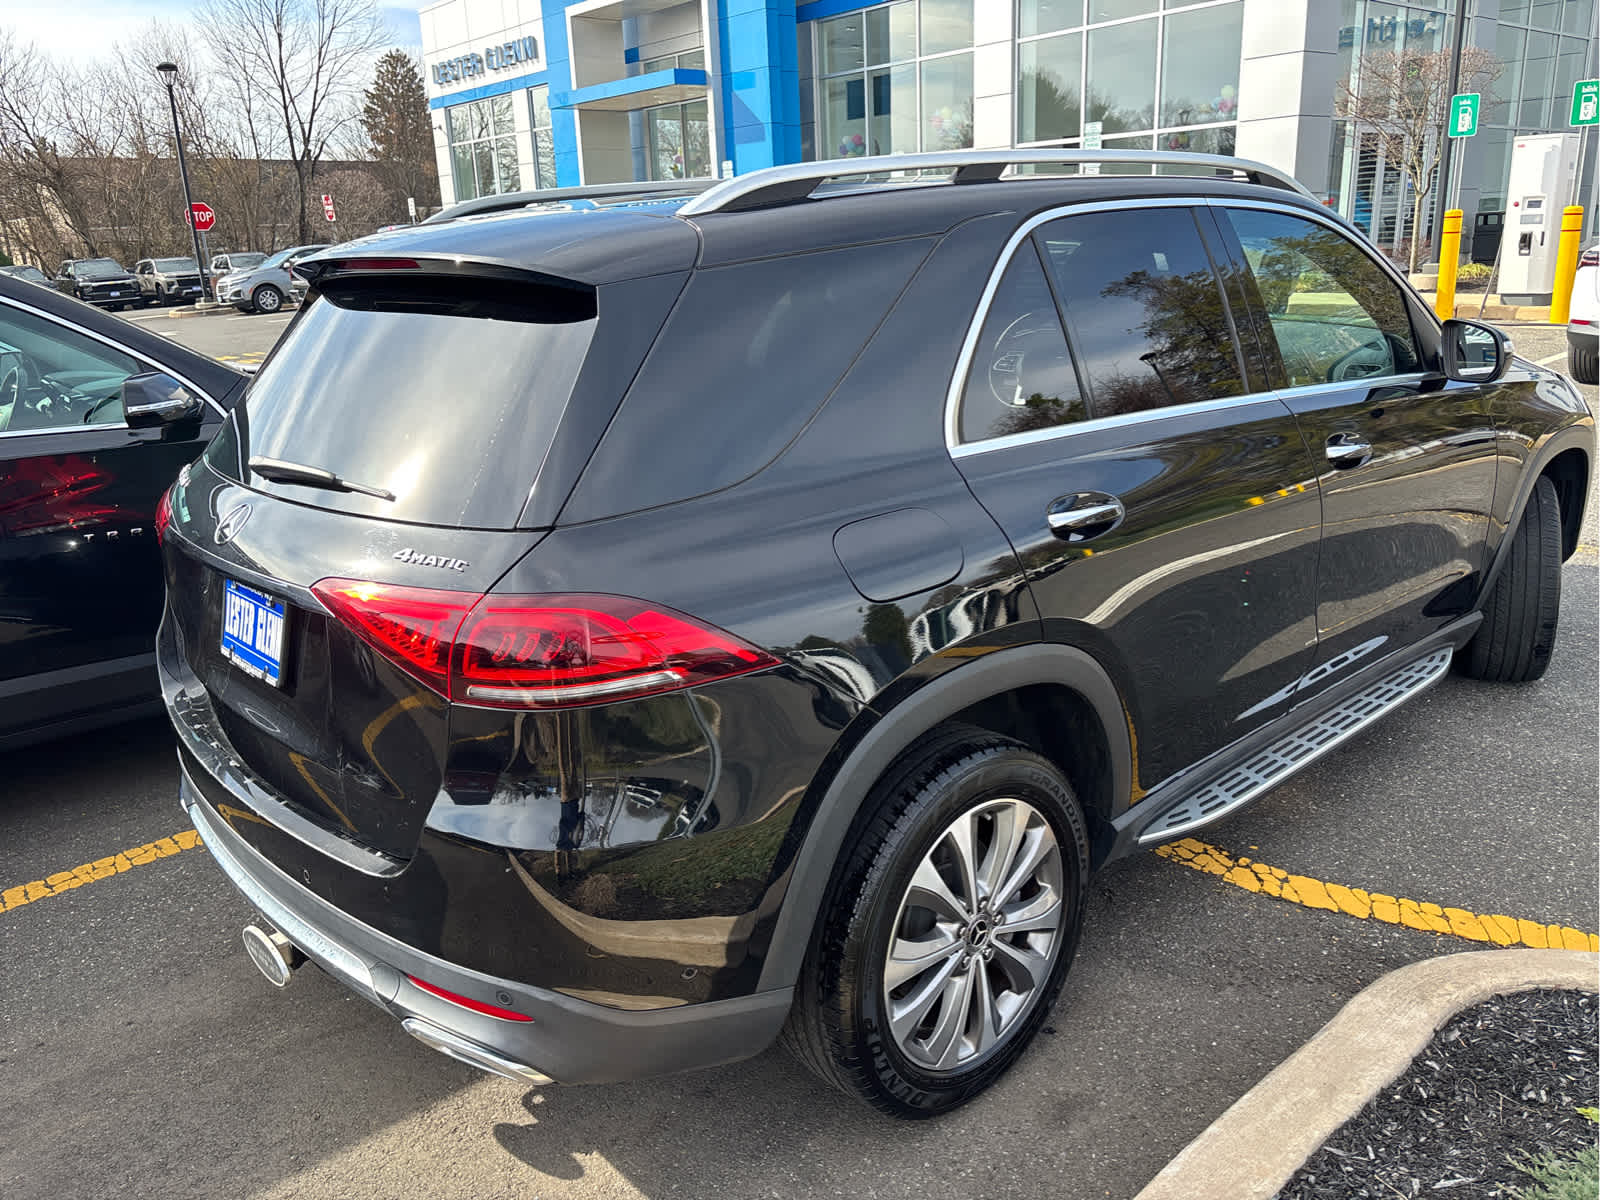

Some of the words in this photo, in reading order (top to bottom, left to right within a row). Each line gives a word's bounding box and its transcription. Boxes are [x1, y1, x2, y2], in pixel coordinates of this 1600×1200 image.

[432, 52, 484, 85] LESTER
[188, 211, 212, 223] TOP
[392, 547, 470, 572] 4MATIC
[224, 591, 255, 646] LESTER
